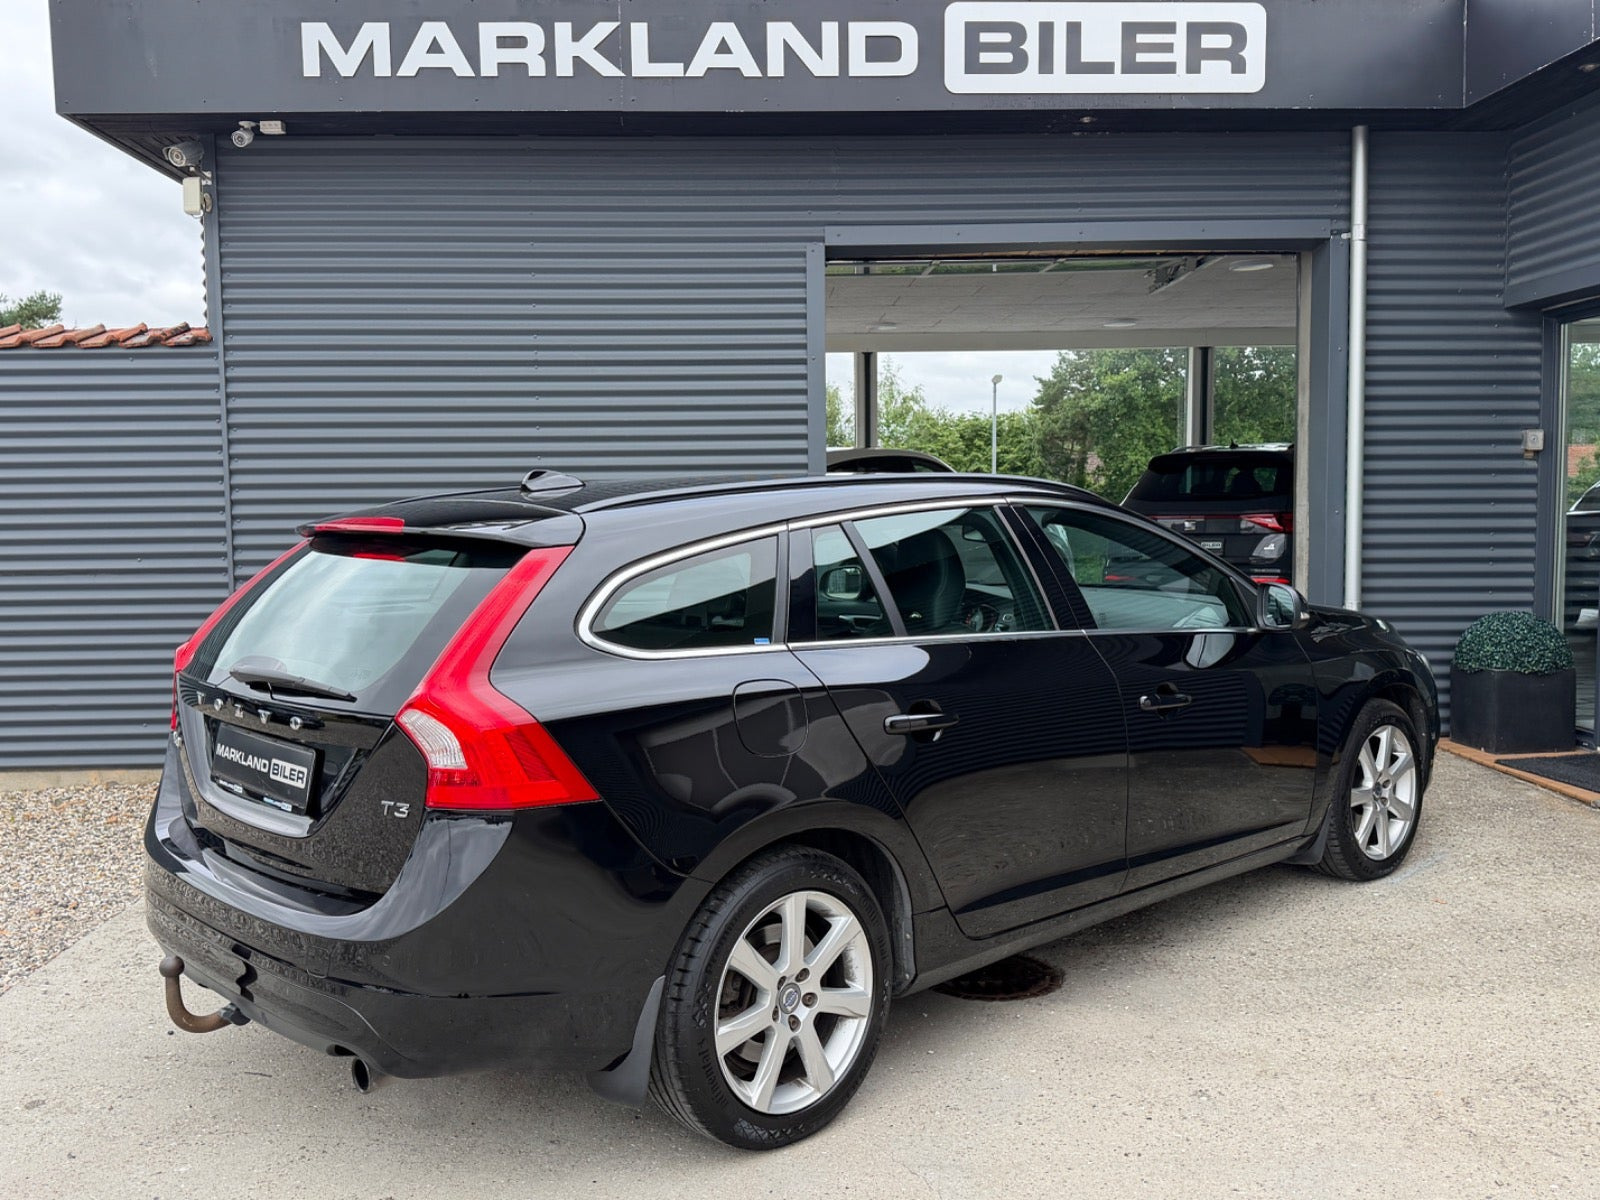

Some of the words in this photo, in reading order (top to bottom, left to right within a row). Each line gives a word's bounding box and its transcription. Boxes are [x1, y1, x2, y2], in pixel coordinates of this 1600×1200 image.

[301, 21, 918, 77] MARKLAND
[963, 20, 1248, 75] BILER
[216, 743, 270, 774] MARKLAND
[271, 762, 306, 785] BILER
[381, 800, 410, 818] T3
